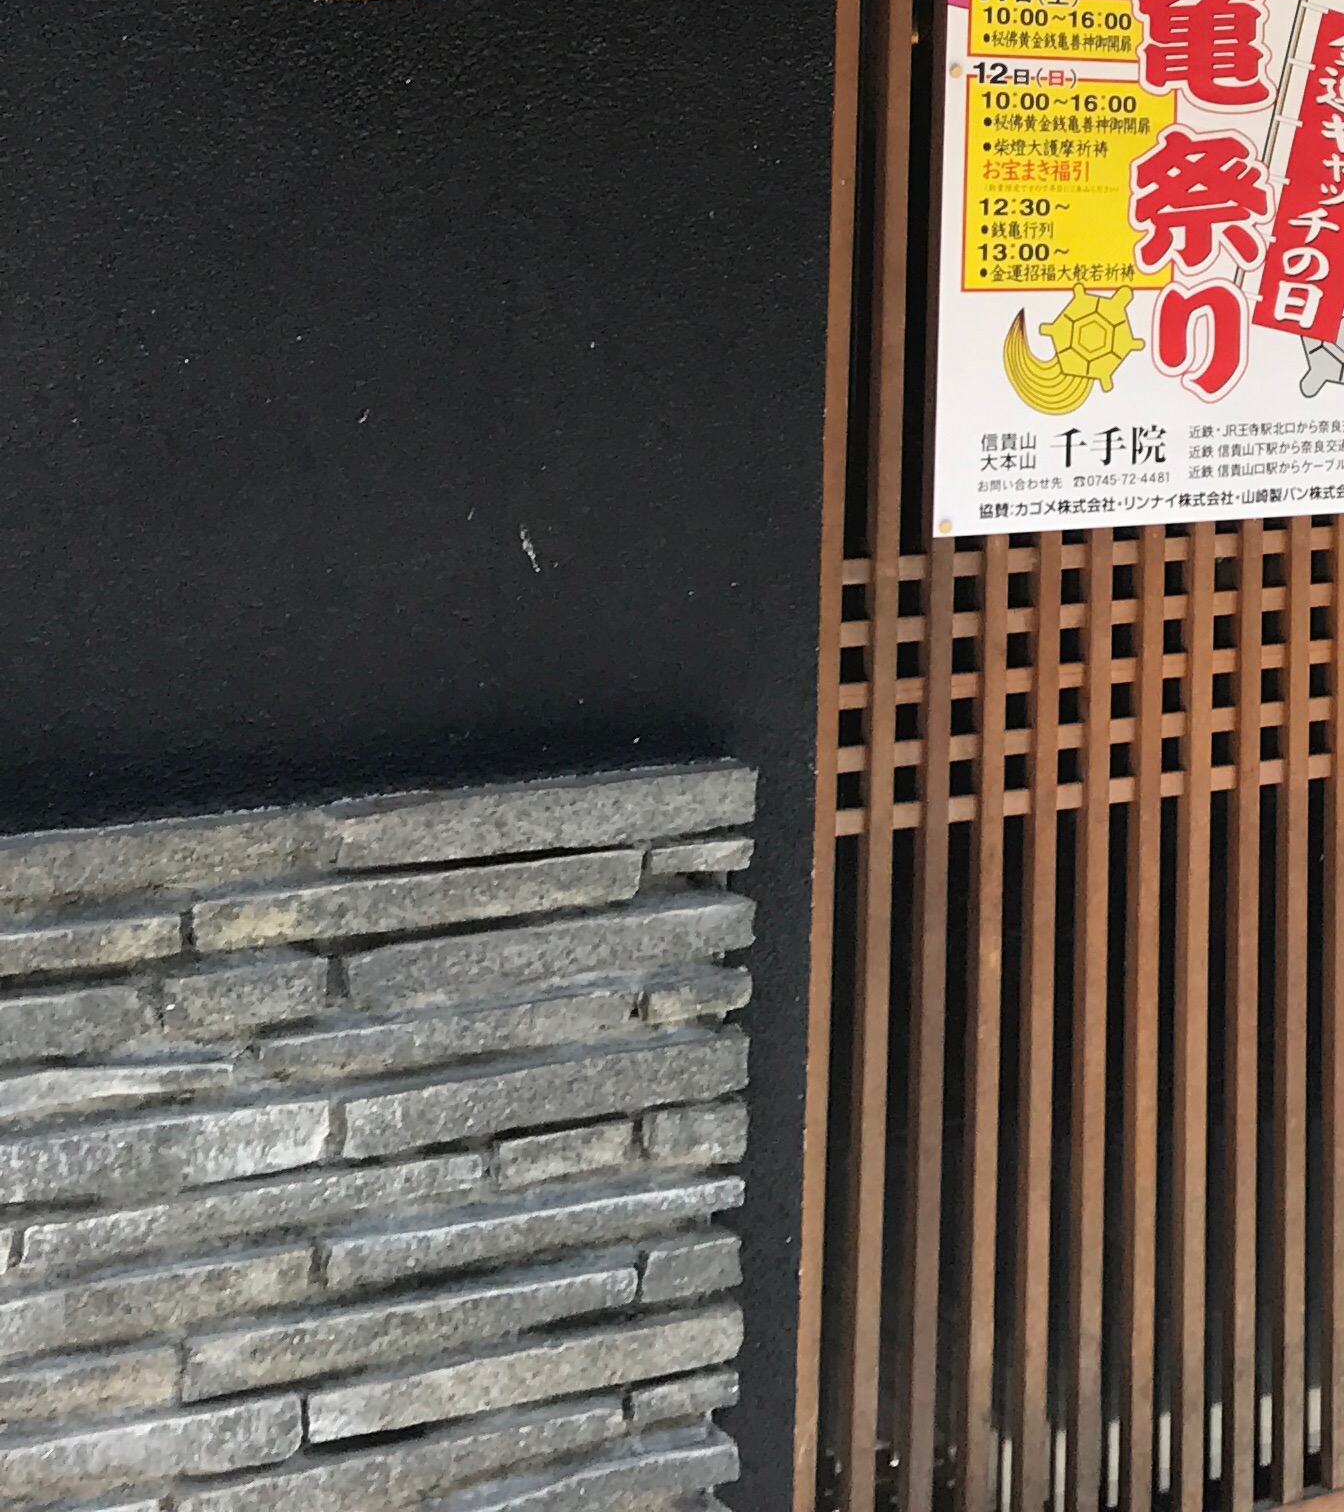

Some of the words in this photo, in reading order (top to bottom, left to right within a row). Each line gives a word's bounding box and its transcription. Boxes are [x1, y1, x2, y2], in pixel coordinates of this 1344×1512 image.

[982, 158, 1091, 183] お宝まき福引
[991, 220, 1054, 240] 銭亀行列
[981, 431, 1037, 451] 信貴山
[1050, 424, 1168, 468] 千手院
[981, 451, 1037, 472] 大本山
[1188, 444, 1214, 460] 近鉄
[1188, 463, 1214, 480] 近鉄
[977, 476, 1063, 493] お問い合わせ先
